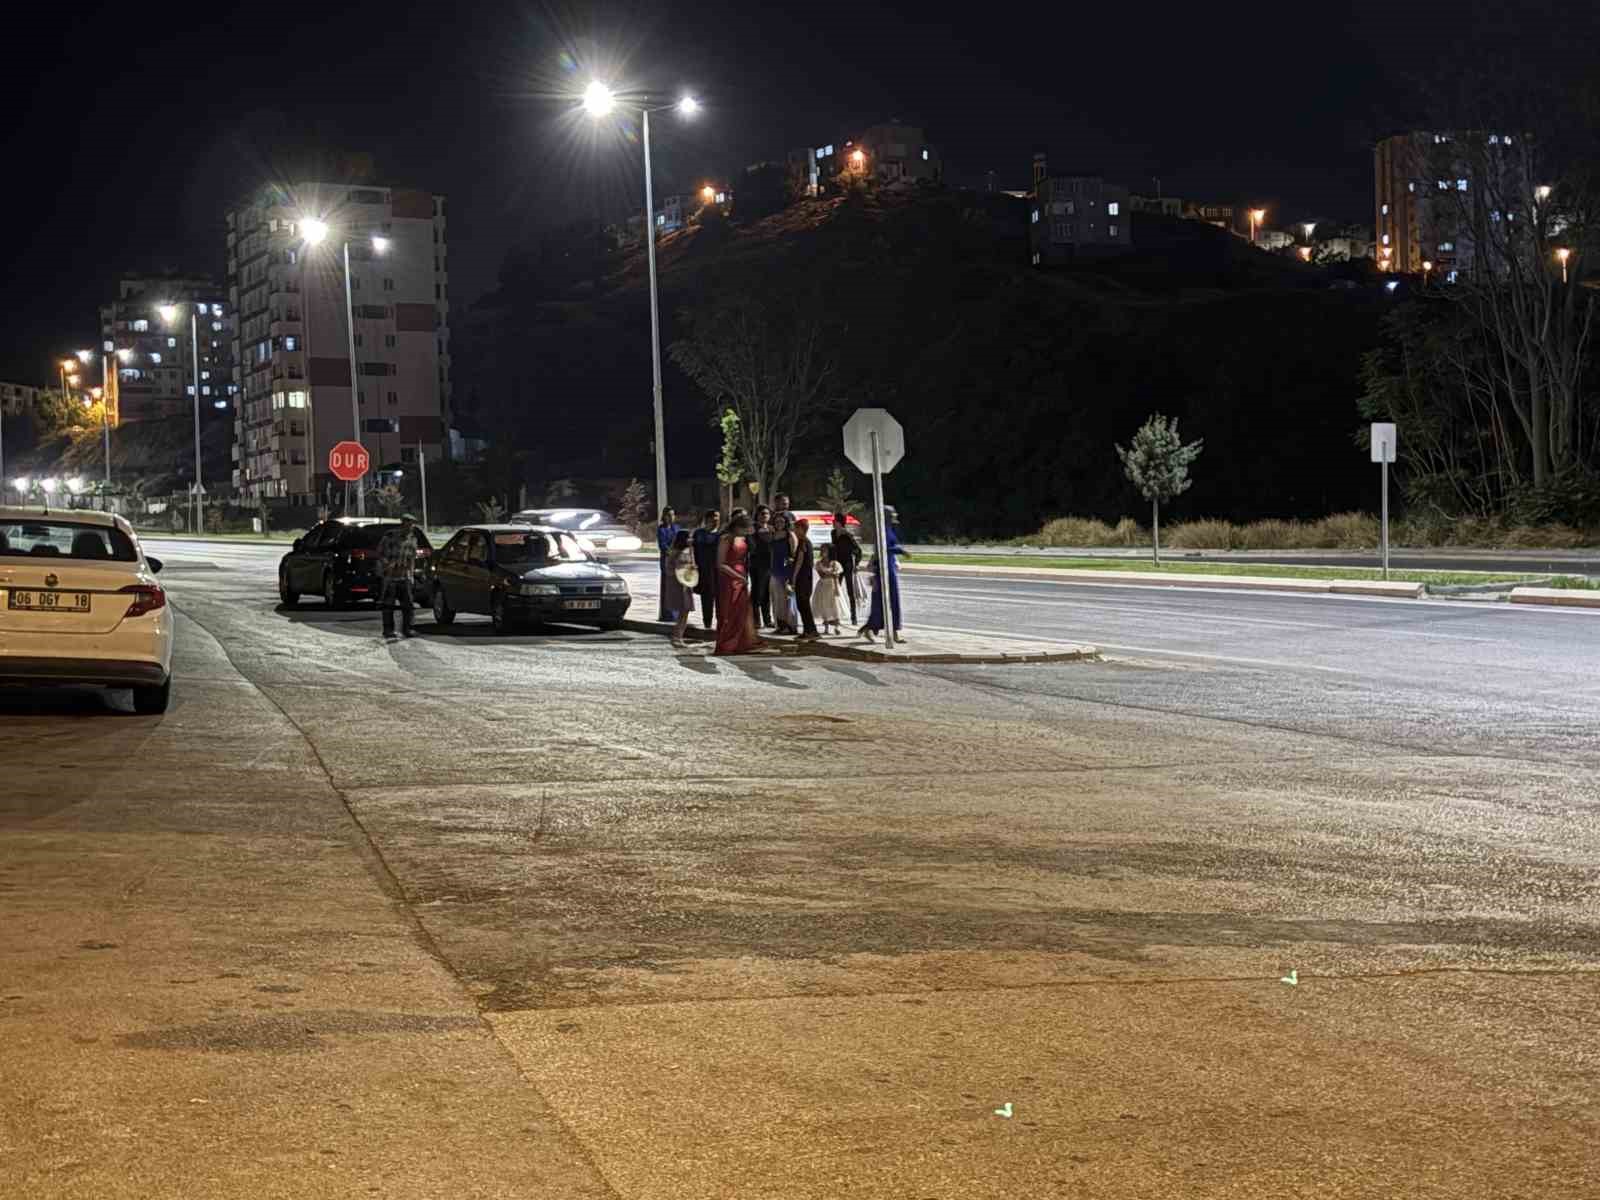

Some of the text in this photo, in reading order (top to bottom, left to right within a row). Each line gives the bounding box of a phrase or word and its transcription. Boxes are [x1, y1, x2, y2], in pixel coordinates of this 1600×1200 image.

[333, 452, 366, 469] DUR
[16, 592, 31, 604] 06
[74, 594, 88, 607] 18
